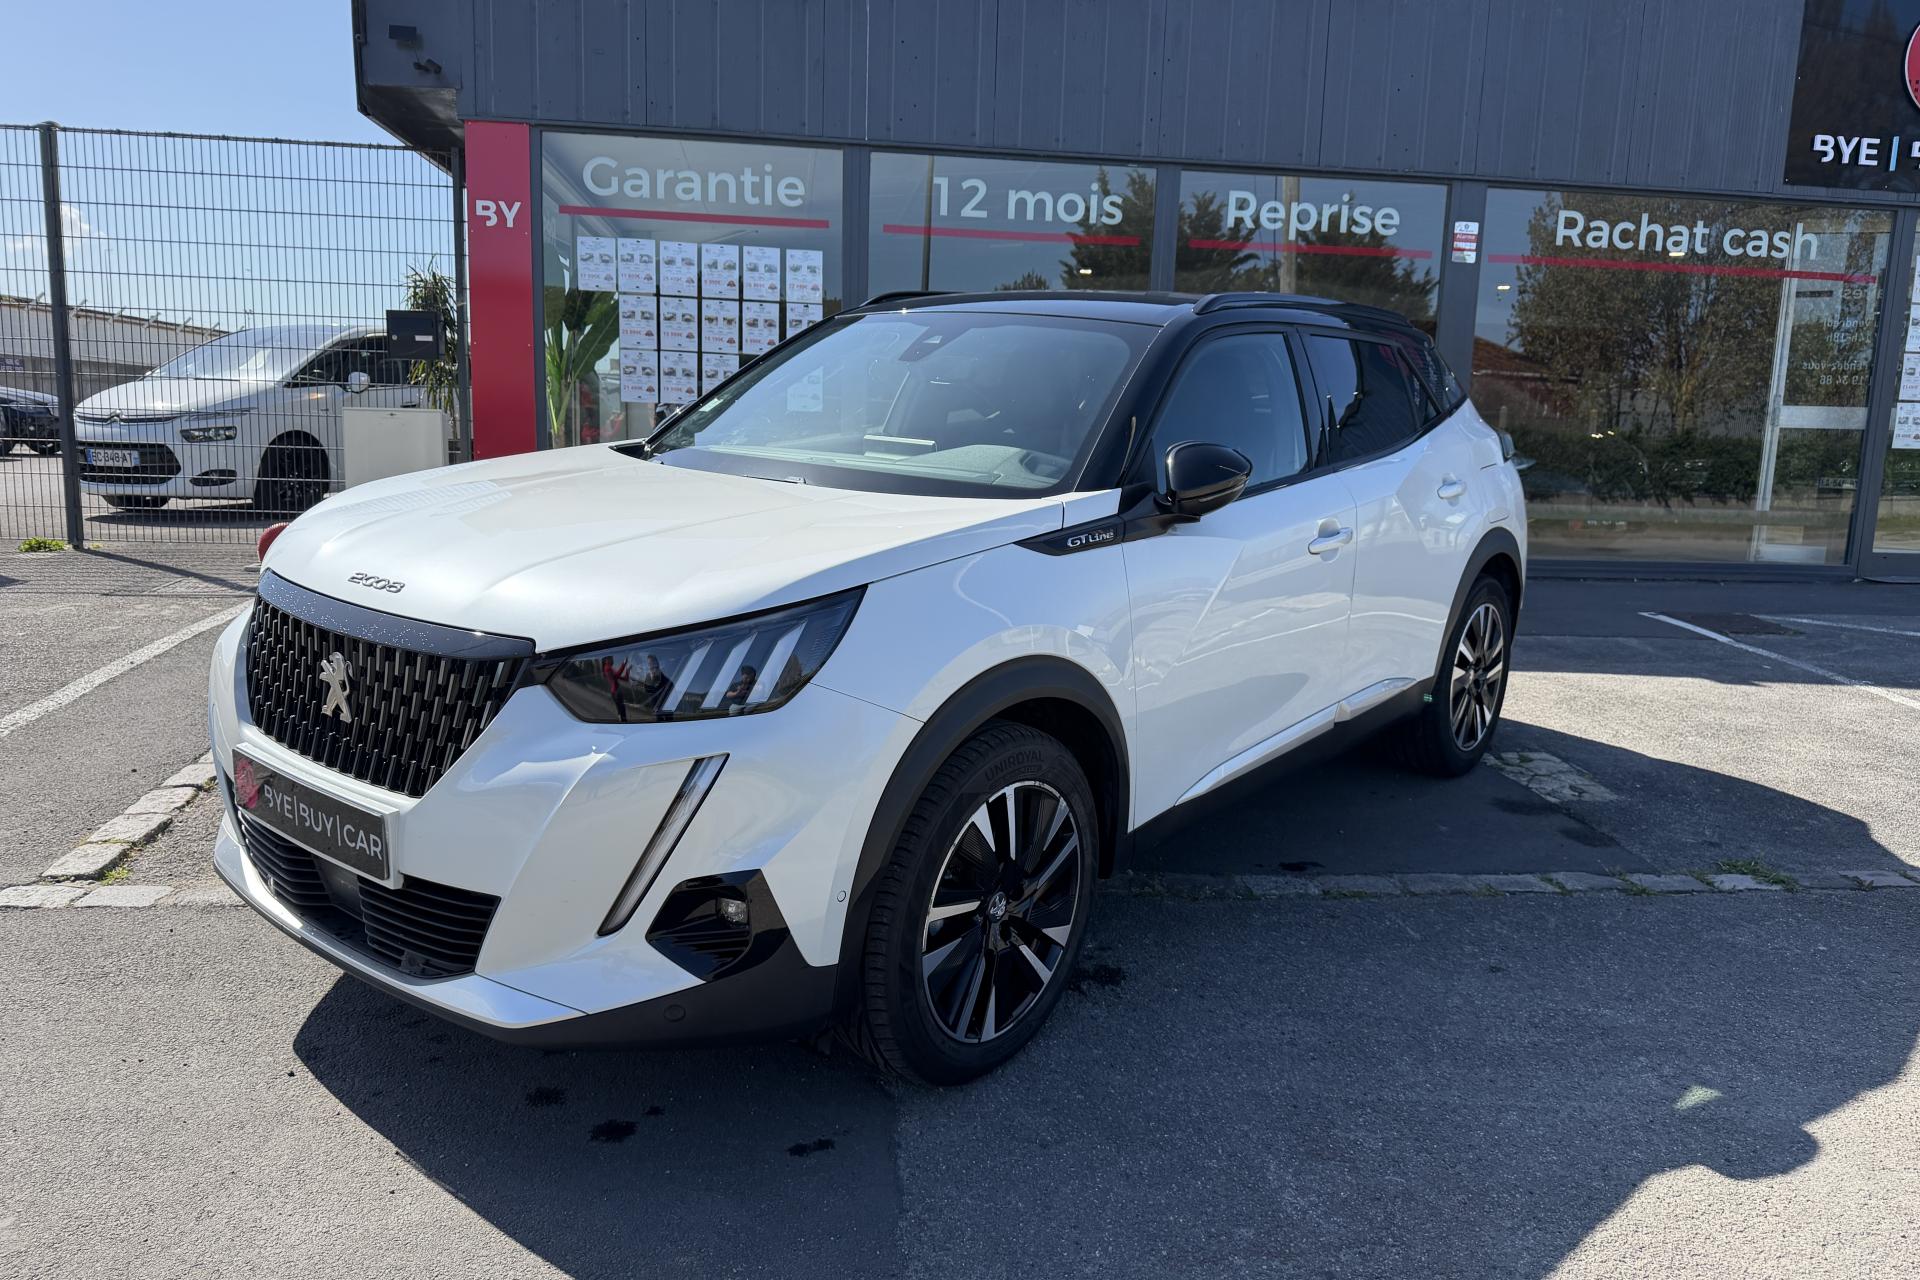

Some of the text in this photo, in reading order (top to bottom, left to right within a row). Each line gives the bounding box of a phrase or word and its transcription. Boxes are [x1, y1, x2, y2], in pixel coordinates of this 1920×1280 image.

[1813, 134, 1881, 166] BYE
[582, 156, 806, 207] Garantie
[933, 175, 1124, 226] 12 mois
[475, 199, 522, 228] BY
[1227, 190, 1401, 240] Reprise
[1555, 209, 1818, 261] Rachat cash
[348, 572, 406, 594] 2008
[984, 749, 1044, 782] UNIROYAL
